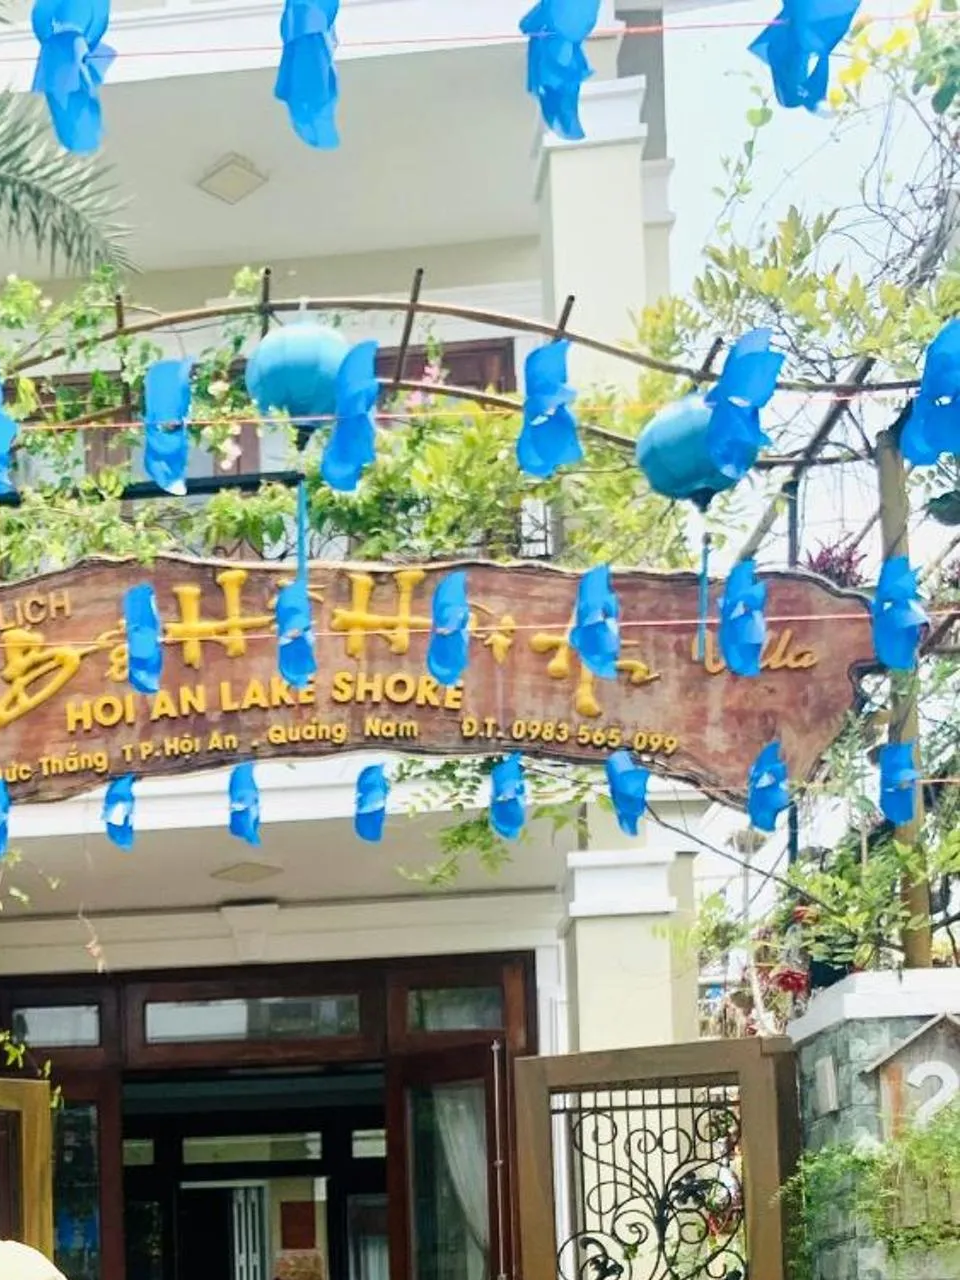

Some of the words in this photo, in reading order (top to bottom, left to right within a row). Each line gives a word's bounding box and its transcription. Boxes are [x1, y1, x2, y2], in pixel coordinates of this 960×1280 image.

[65, 695, 135, 732] HOI
[150, 684, 207, 721] AN
[220, 675, 316, 712] LAKE
[331, 671, 464, 710] SHORE
[208, 730, 239, 750] An
[364, 716, 419, 738] Nam
[512, 719, 569, 743] 0983
[577, 724, 621, 748] 565
[633, 731, 678, 755] 099
